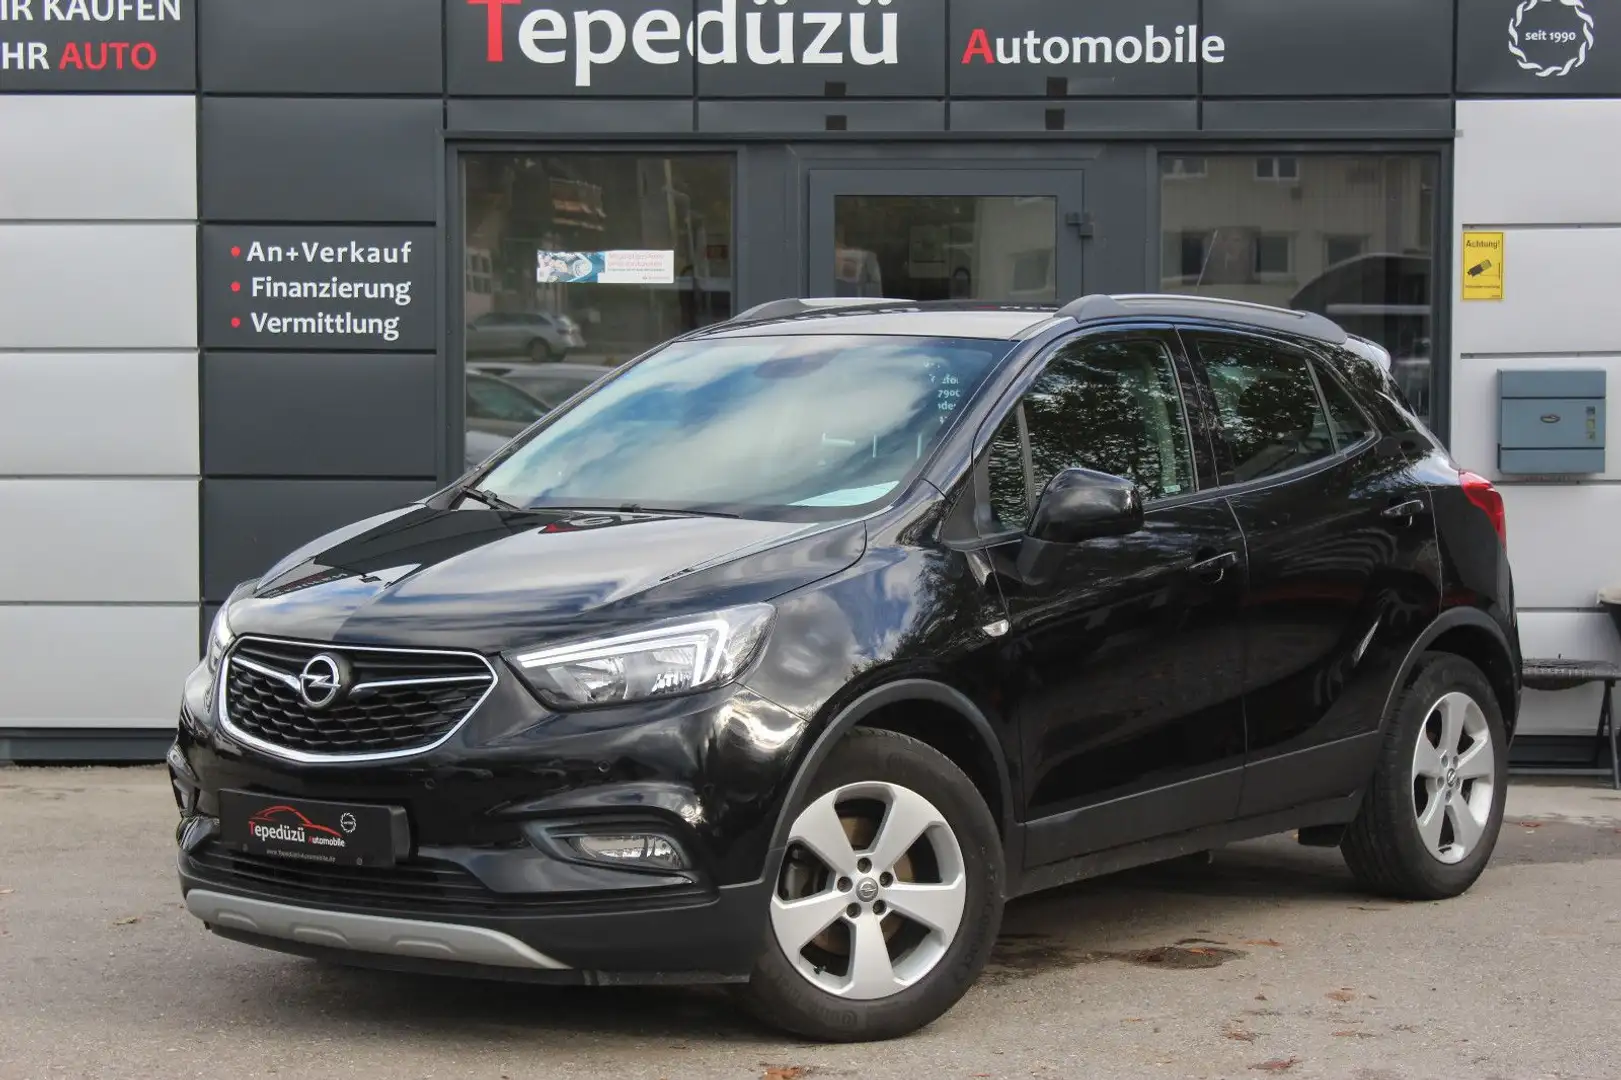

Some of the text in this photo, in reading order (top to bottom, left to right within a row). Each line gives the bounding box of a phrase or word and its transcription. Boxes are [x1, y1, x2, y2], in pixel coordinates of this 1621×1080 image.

[44, 0, 181, 21] KAUFEN
[467, 0, 898, 86] Tepedüzü
[962, 25, 1225, 64] Automobile
[1525, 30, 1576, 43] seit 1990
[59, 42, 157, 70] AUTO
[246, 241, 412, 263] An+Verkauf
[1466, 239, 1500, 249] Achtung!
[251, 277, 412, 305] Finanzierung
[251, 312, 400, 341] Vermittlung
[249, 821, 345, 848] Tepedüzü Automobile
